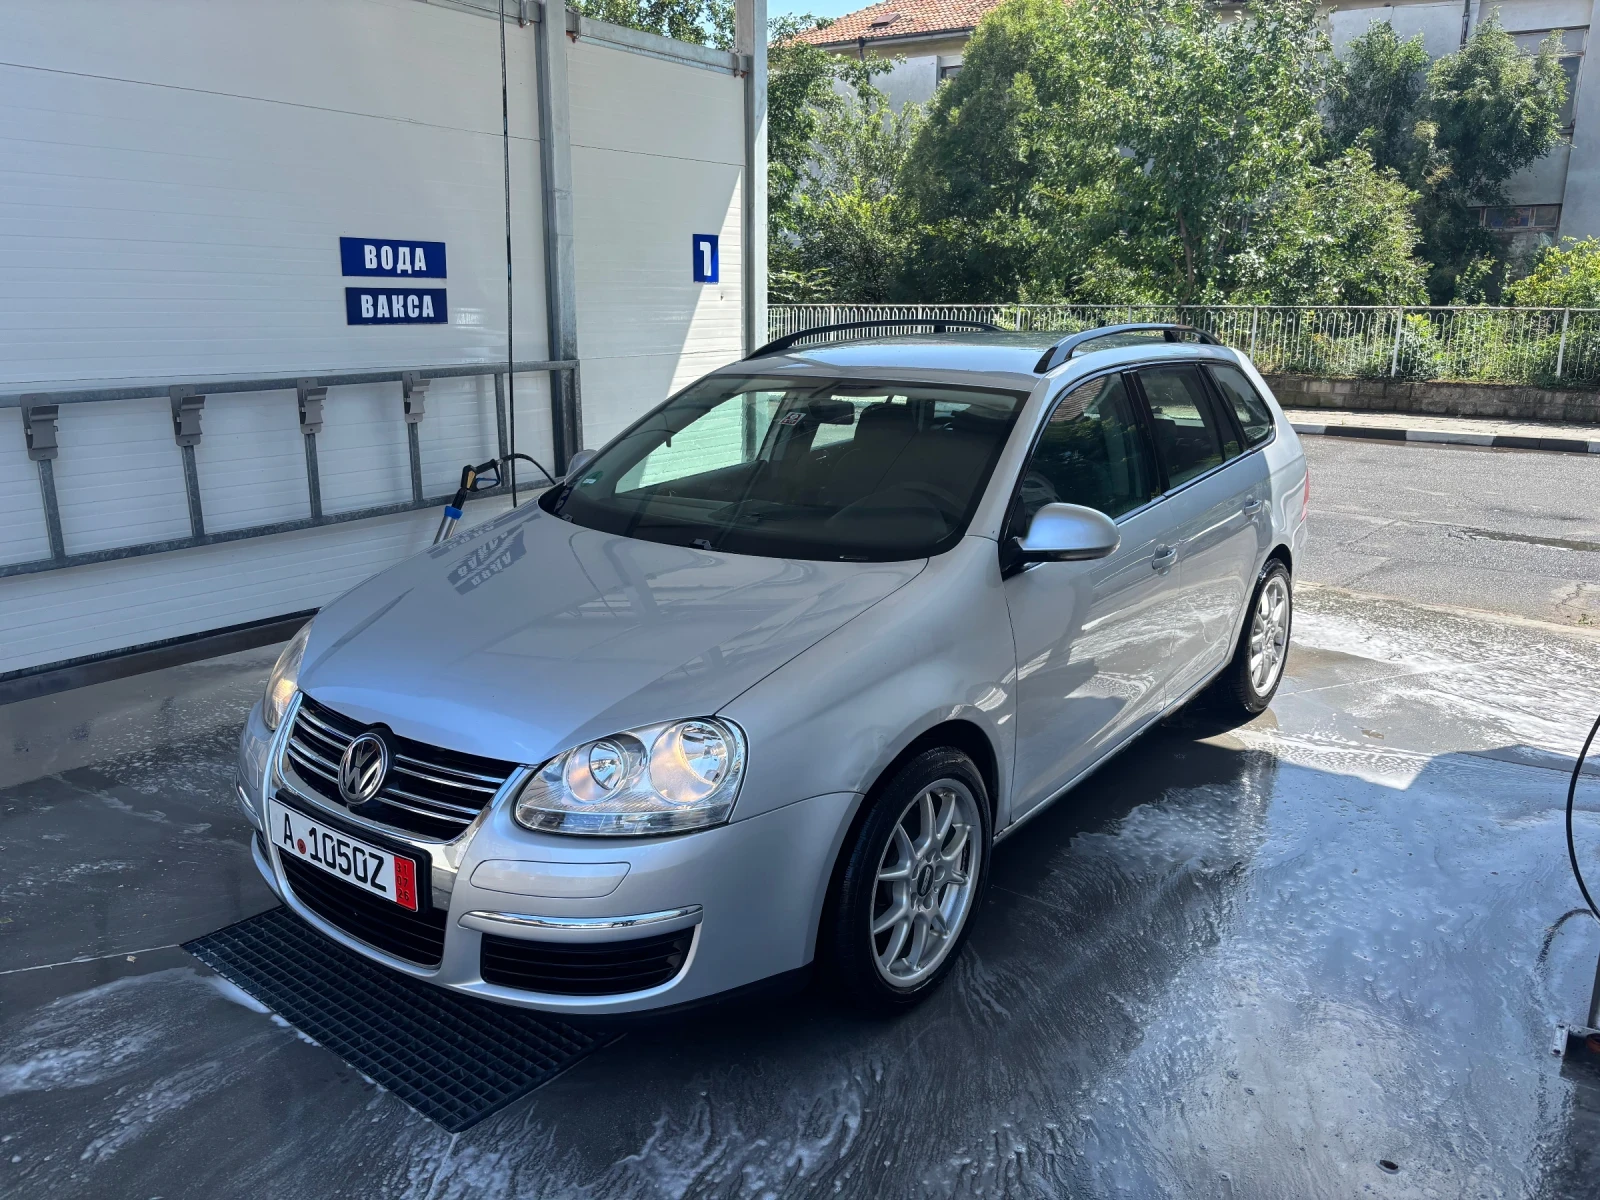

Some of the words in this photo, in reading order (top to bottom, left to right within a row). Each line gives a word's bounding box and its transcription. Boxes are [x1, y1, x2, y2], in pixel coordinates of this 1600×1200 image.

[364, 244, 427, 274] ВОДА
[700, 241, 711, 276] 1
[360, 294, 435, 318] ВАКСА
[283, 812, 295, 849] A
[396, 861, 408, 876] 31
[397, 874, 409, 888] 07
[398, 887, 410, 902] 26
